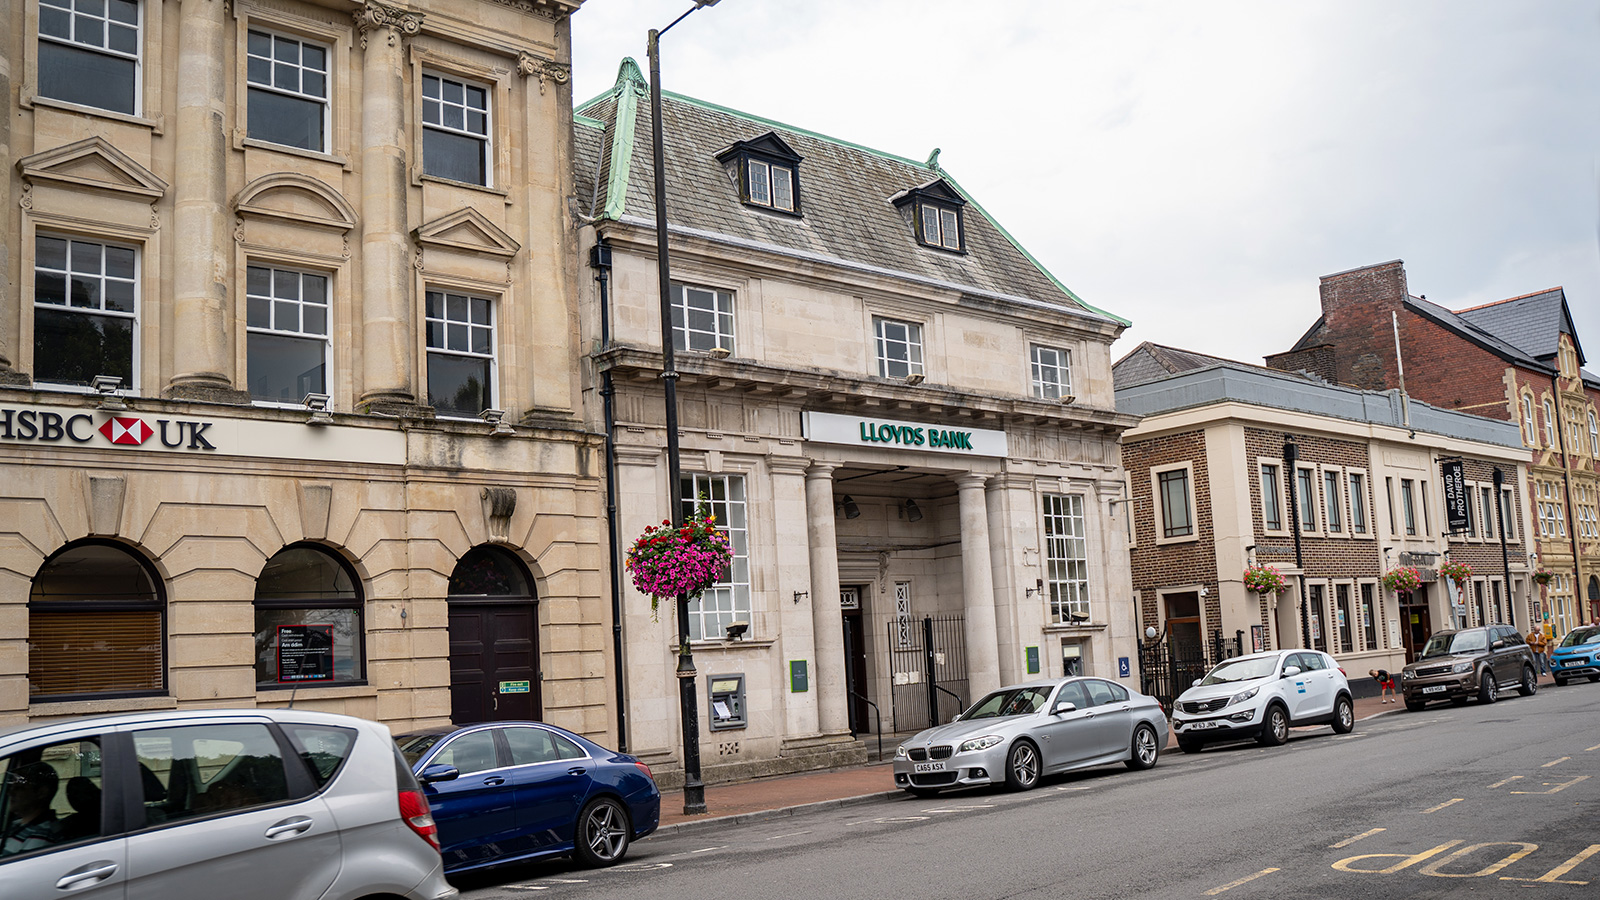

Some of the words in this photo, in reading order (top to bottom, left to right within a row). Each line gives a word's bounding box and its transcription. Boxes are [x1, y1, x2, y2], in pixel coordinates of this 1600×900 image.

[0, 409, 94, 442] HSBC
[157, 420, 217, 450] UK
[860, 421, 925, 446] LLOYDS
[928, 429, 974, 450] BANK
[1445, 474, 1455, 499] DAVID
[1453, 466, 1465, 516] PROTHEROE
